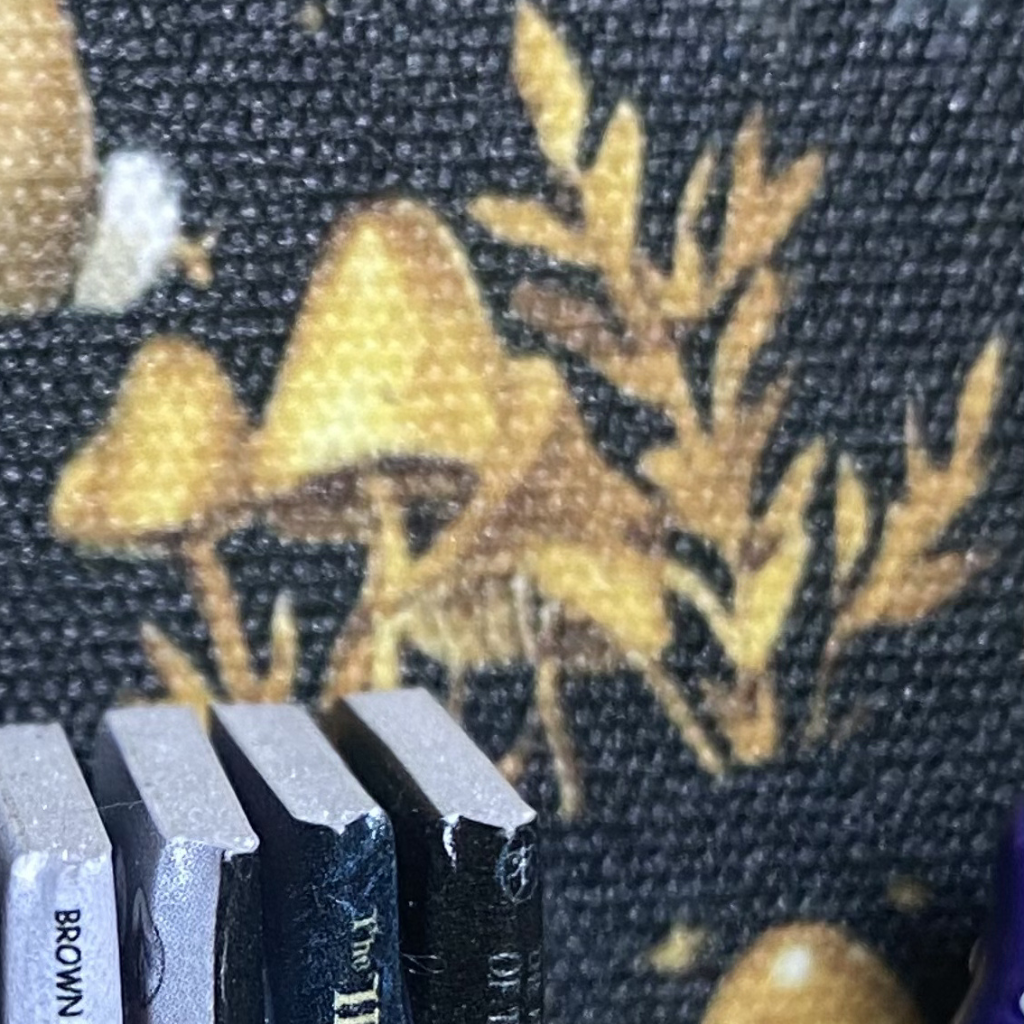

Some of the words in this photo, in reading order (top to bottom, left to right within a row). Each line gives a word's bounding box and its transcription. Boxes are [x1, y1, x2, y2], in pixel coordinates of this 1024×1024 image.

[54, 909, 83, 1018] BROWN
[351, 908, 379, 972] The
[486, 952, 523, 992] OF
